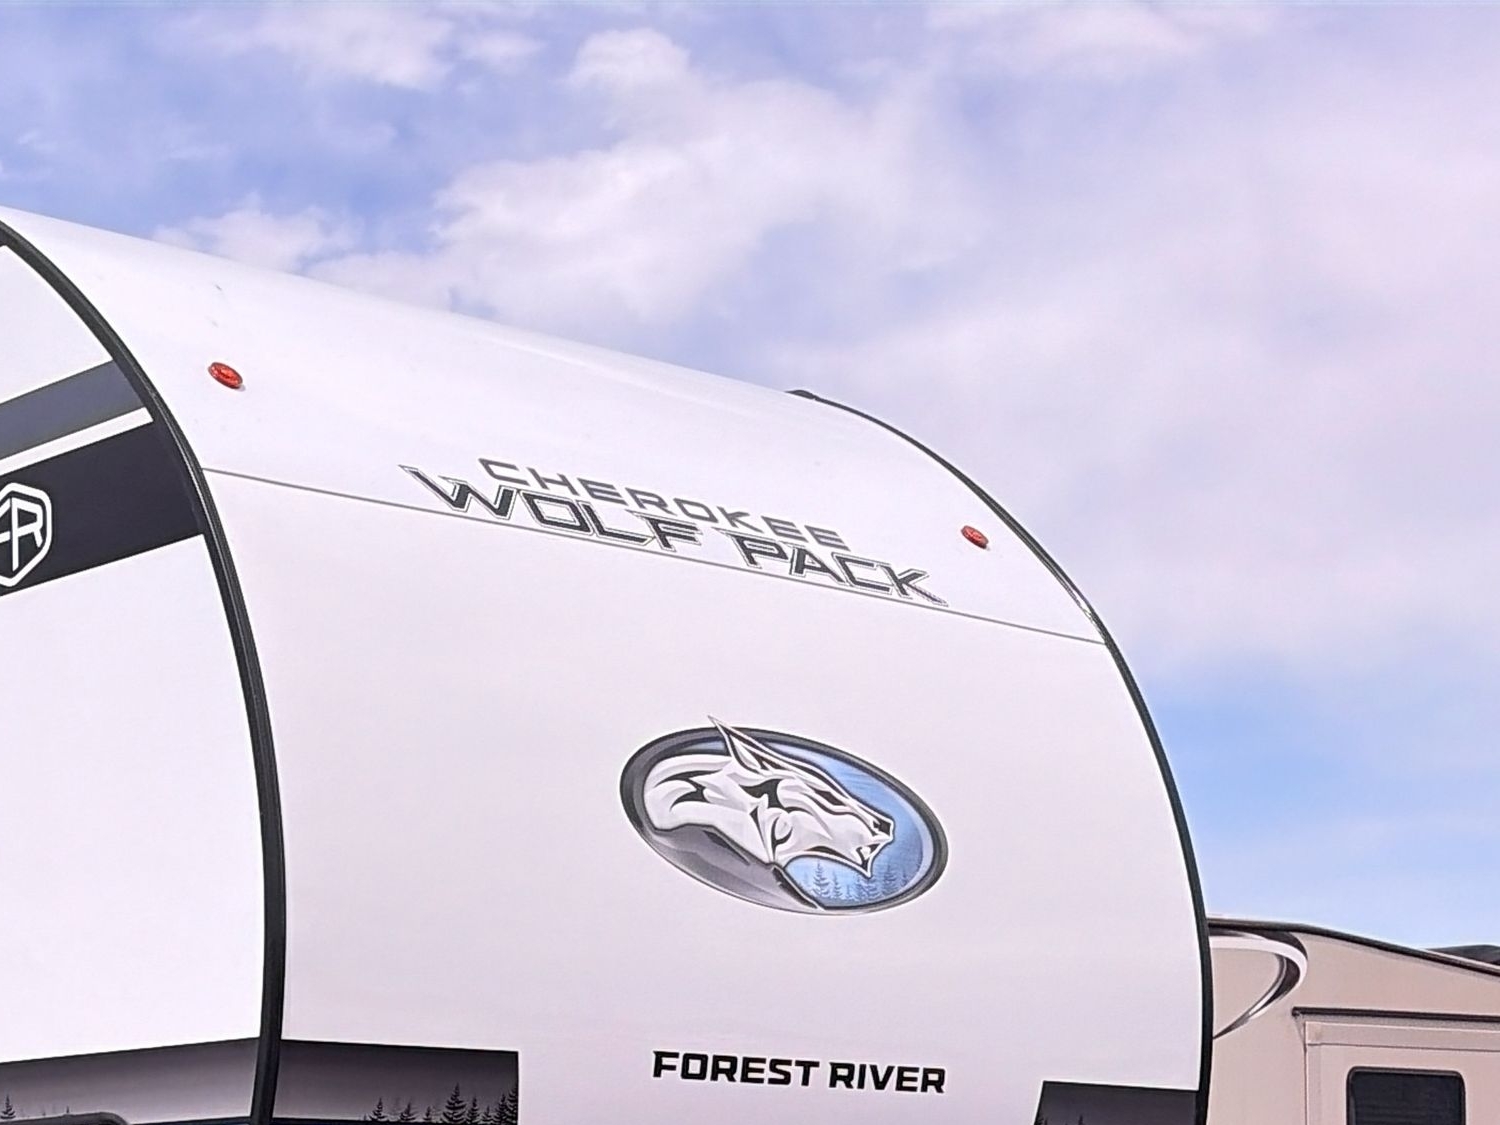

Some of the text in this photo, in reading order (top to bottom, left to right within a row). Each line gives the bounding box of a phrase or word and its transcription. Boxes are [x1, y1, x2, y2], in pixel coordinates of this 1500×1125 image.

[398, 464, 950, 607] WOLF PACK
[478, 457, 851, 551] CHEROKEE
[653, 1050, 946, 1094] FOREST RIVER
